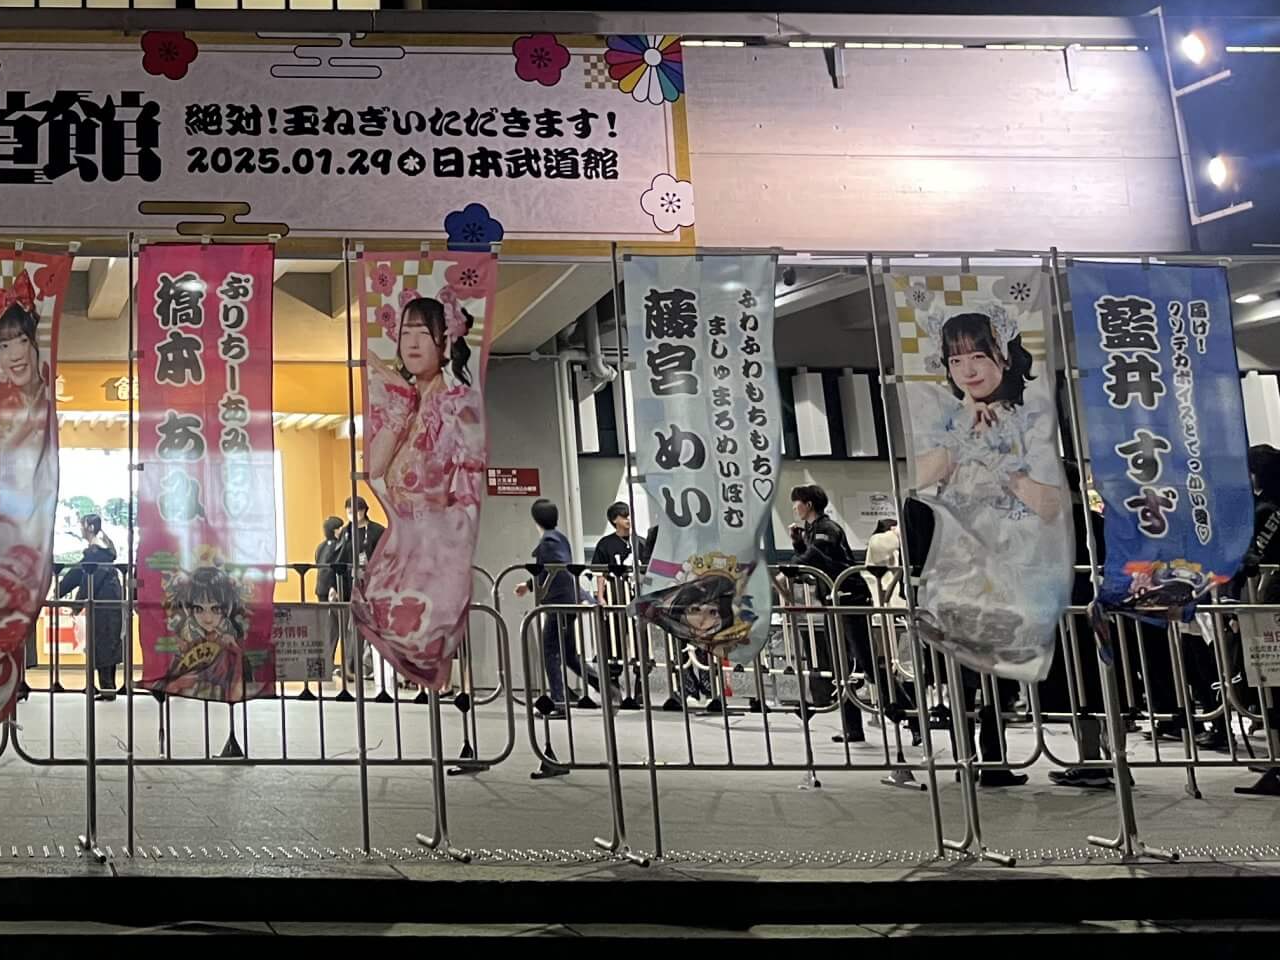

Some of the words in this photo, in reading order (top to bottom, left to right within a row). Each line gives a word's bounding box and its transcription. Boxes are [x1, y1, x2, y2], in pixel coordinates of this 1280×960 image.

[185, 103, 617, 139] 絶対！玉ねぎいただきます！
[154, 273, 206, 385] 橋本
[644, 288, 698, 396] 藤宮
[1095, 296, 1167, 409] 藍井
[654, 424, 712, 528] めい
[1116, 428, 1178, 538] すず
